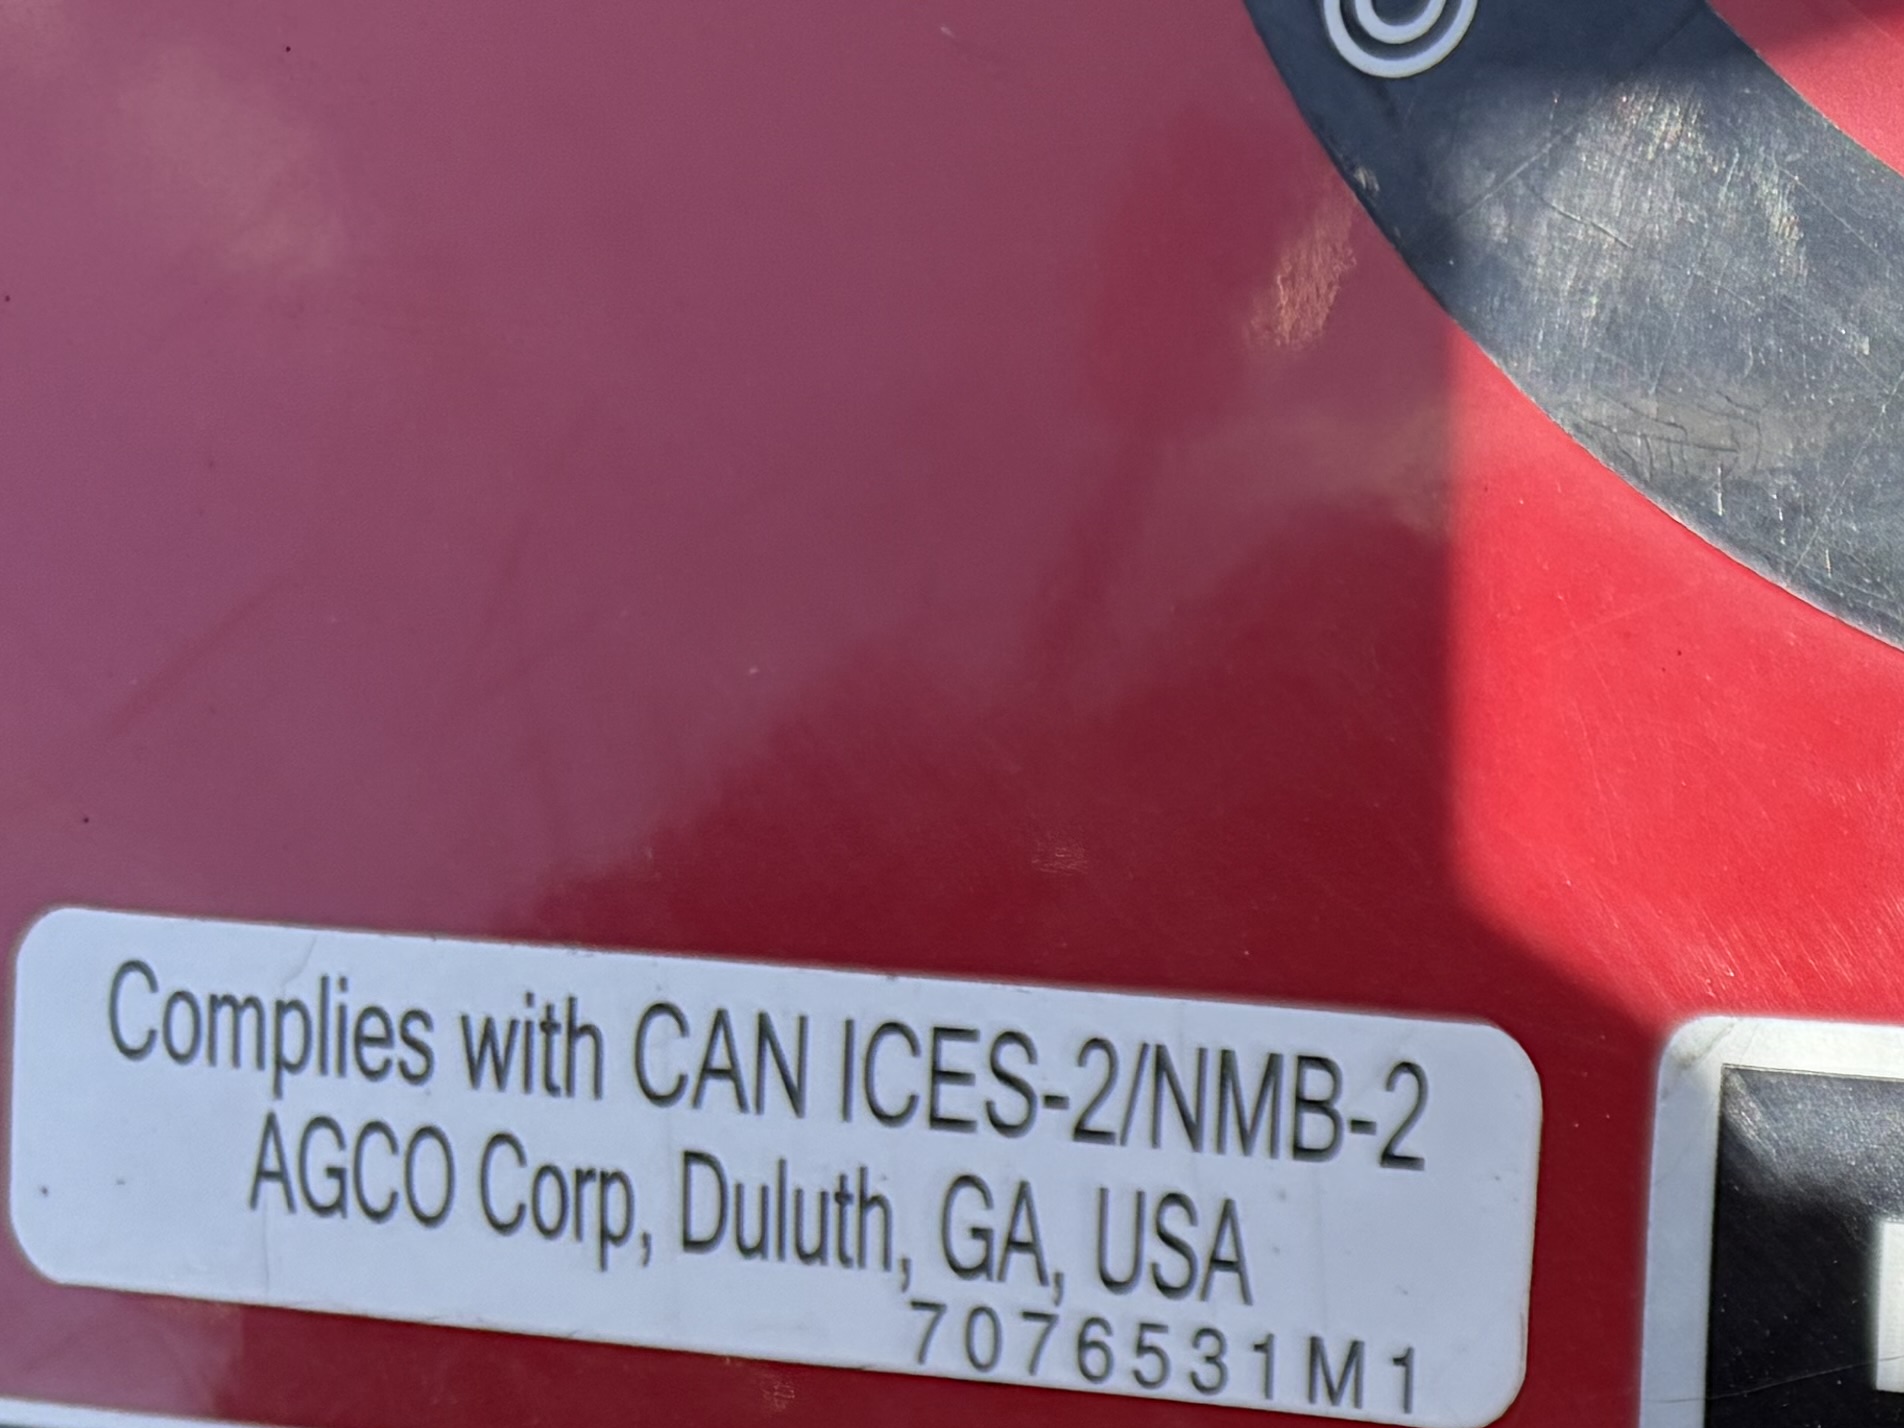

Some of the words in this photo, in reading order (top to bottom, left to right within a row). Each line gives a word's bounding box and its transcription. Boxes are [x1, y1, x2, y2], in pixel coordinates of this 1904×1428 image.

[108, 960, 434, 1117] Complies
[460, 991, 602, 1100] with
[634, 1005, 804, 1117] CAN
[840, 1029, 1428, 1170] ICES-2/NMB-2
[248, 1112, 454, 1228] AGCO
[479, 1132, 653, 1271] Corp,
[680, 1151, 913, 1294] Duluth,
[940, 1173, 1067, 1308] GA,
[1095, 1194, 1252, 1305] USA
[907, 1300, 1417, 1414] 7076531M1
